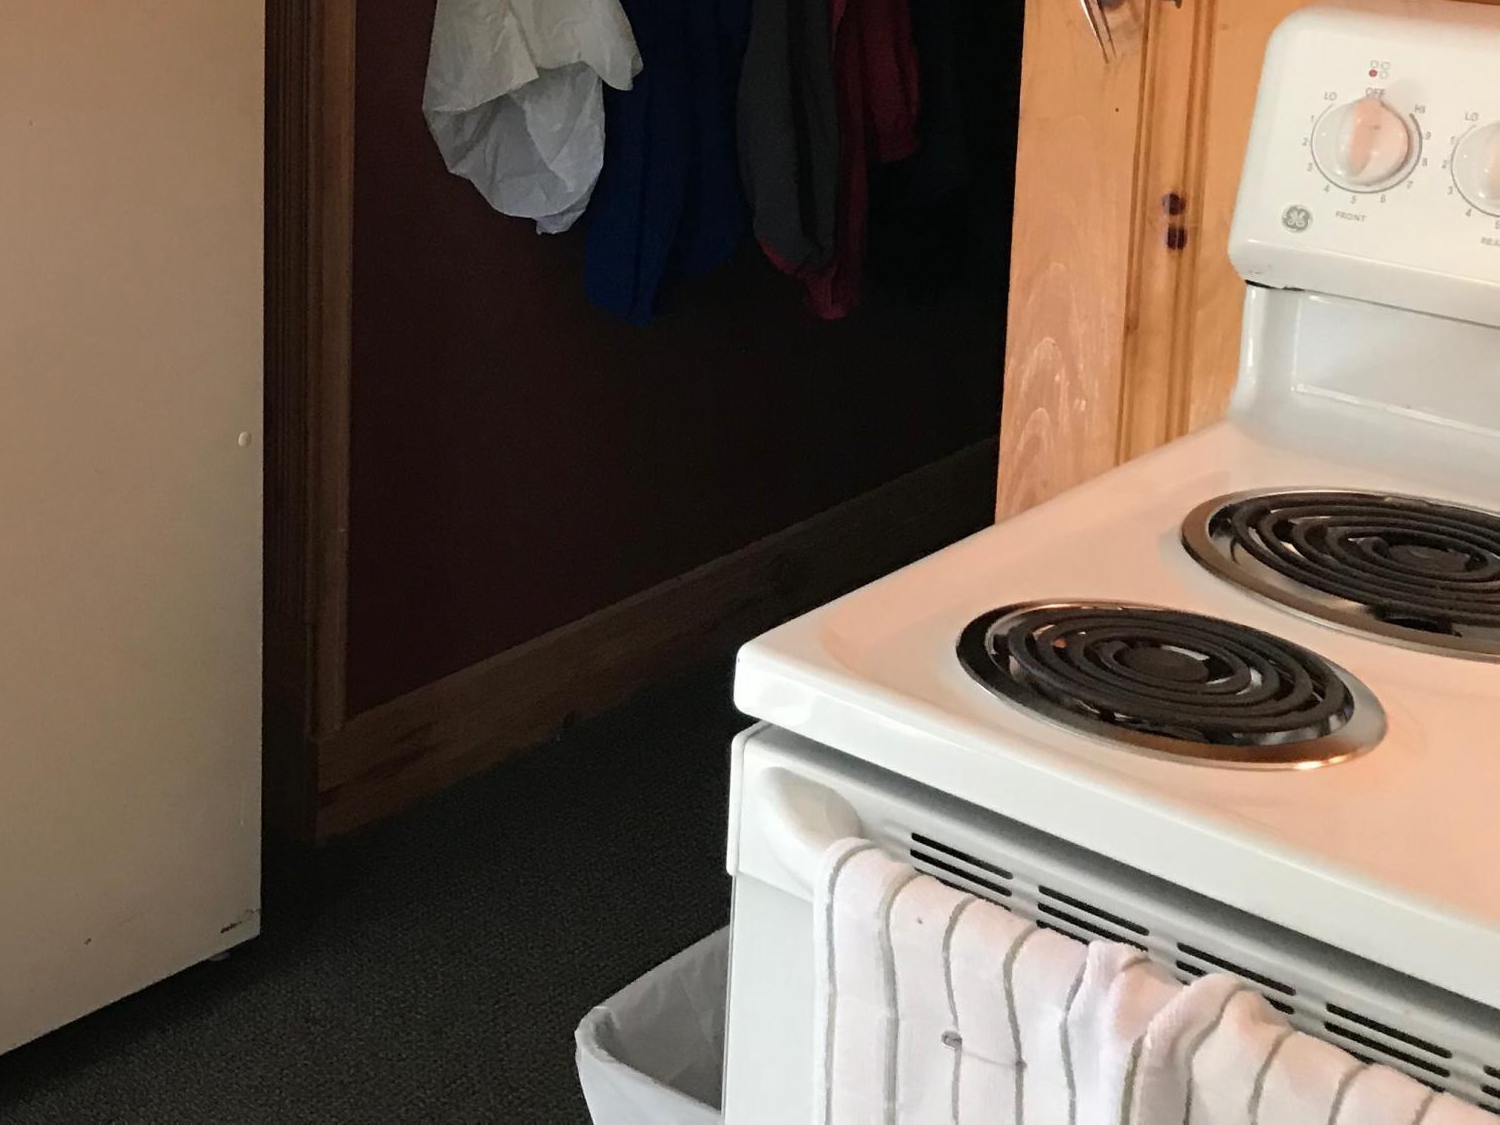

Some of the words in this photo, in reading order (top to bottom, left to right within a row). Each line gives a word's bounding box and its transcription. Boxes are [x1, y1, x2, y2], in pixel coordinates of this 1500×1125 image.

[1323, 91, 1338, 102] LO
[1365, 87, 1386, 99] OFF
[1414, 104, 1426, 114] HI
[1464, 112, 1479, 122] LO
[1335, 210, 1367, 222] FRONT
